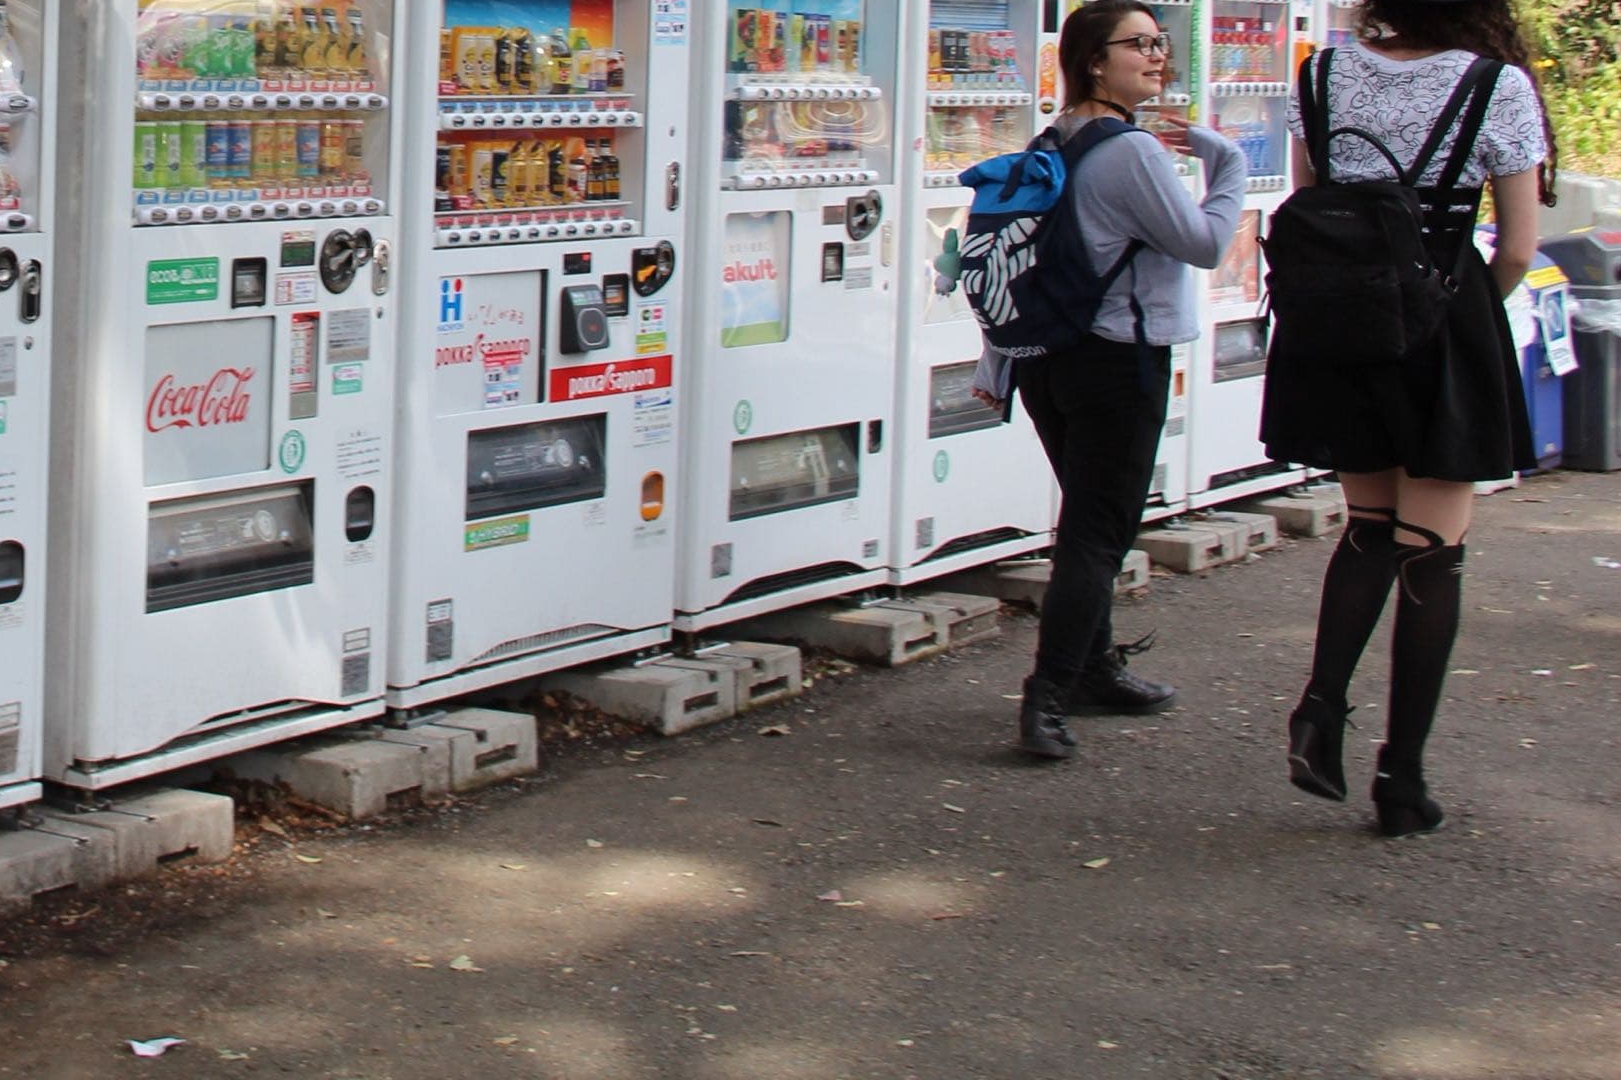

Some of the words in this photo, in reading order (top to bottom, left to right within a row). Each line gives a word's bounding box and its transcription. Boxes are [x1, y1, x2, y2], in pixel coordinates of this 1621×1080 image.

[146, 366, 257, 433] Coca-Cola
[567, 374, 604, 399] pokka
[605, 363, 656, 392] sapporo
